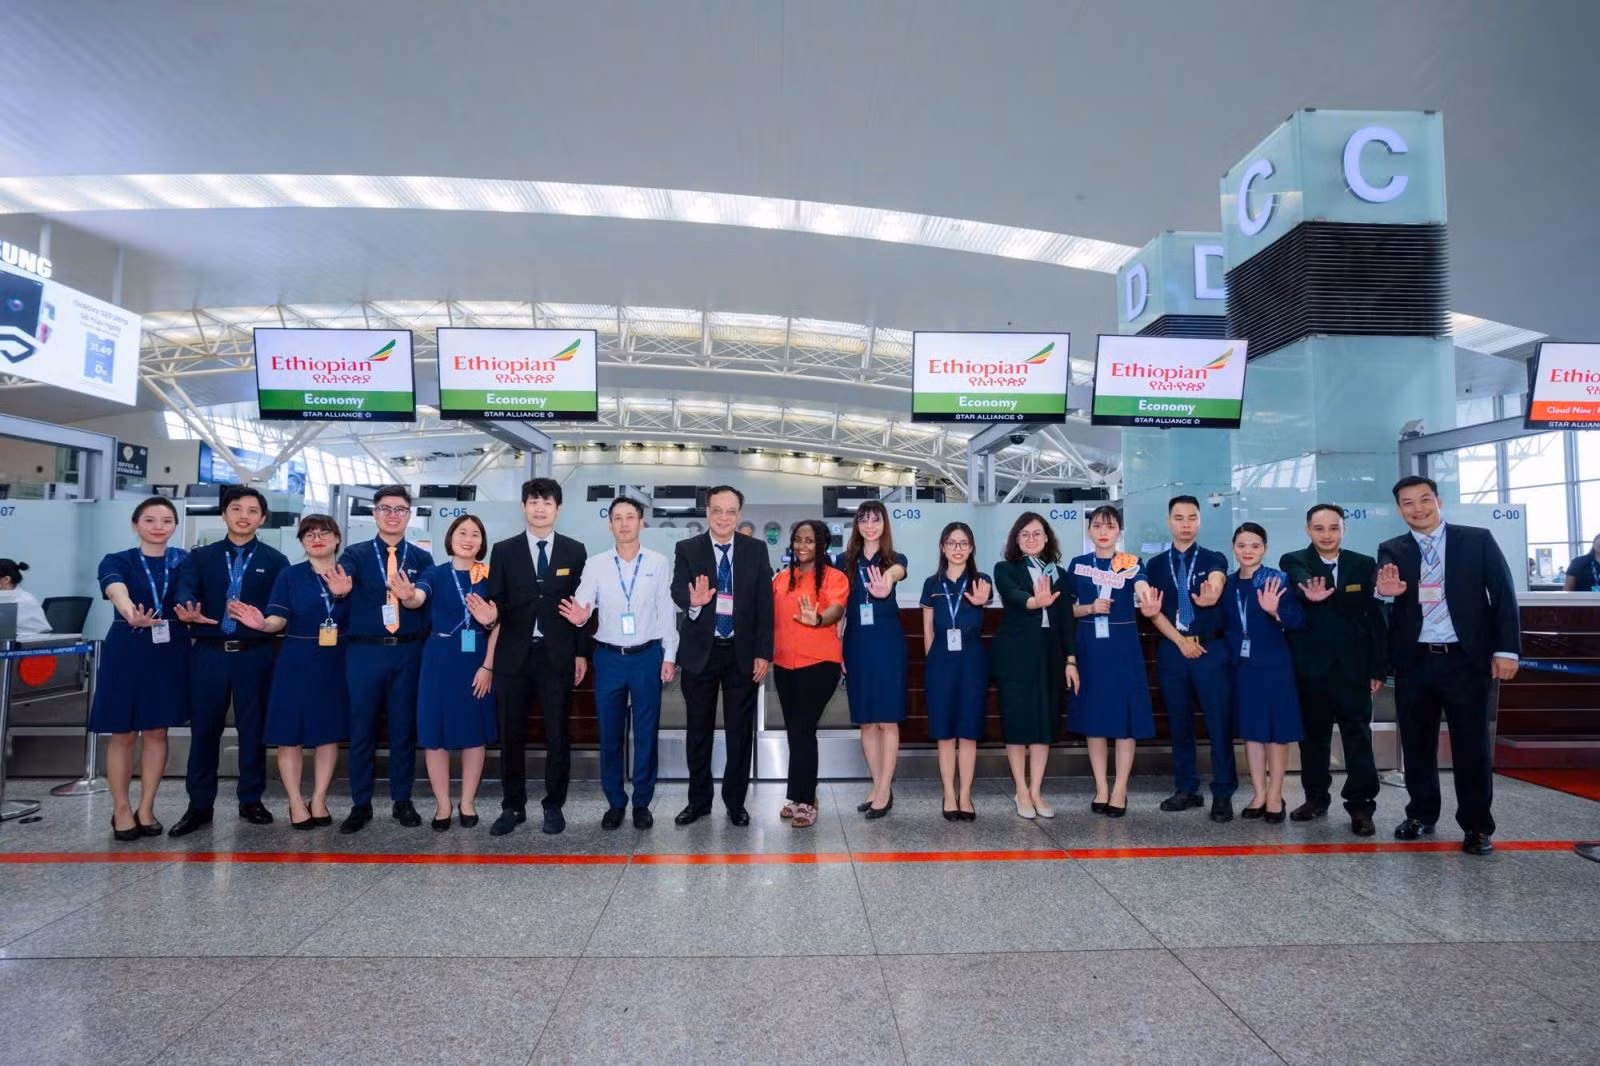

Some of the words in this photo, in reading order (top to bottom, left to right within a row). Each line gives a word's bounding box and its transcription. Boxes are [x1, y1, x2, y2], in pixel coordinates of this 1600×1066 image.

[1344, 126, 1408, 202] C
[1238, 159, 1274, 236] C
[0, 239, 52, 278] UNG
[1126, 263, 1147, 321] D
[271, 356, 372, 374] Ethiopian
[454, 356, 555, 374] Ethiopian
[929, 359, 1029, 377] Ethiopian
[1112, 362, 1207, 381] Ethiopian
[304, 393, 364, 408] Economy
[487, 393, 547, 407] Economy
[959, 396, 1017, 410] Economy
[1139, 400, 1196, 415] Economy
[439, 507, 467, 517] C-05
[893, 509, 921, 519] C-03
[1050, 509, 1077, 520] C-02
[1493, 509, 1520, 519] C-00
